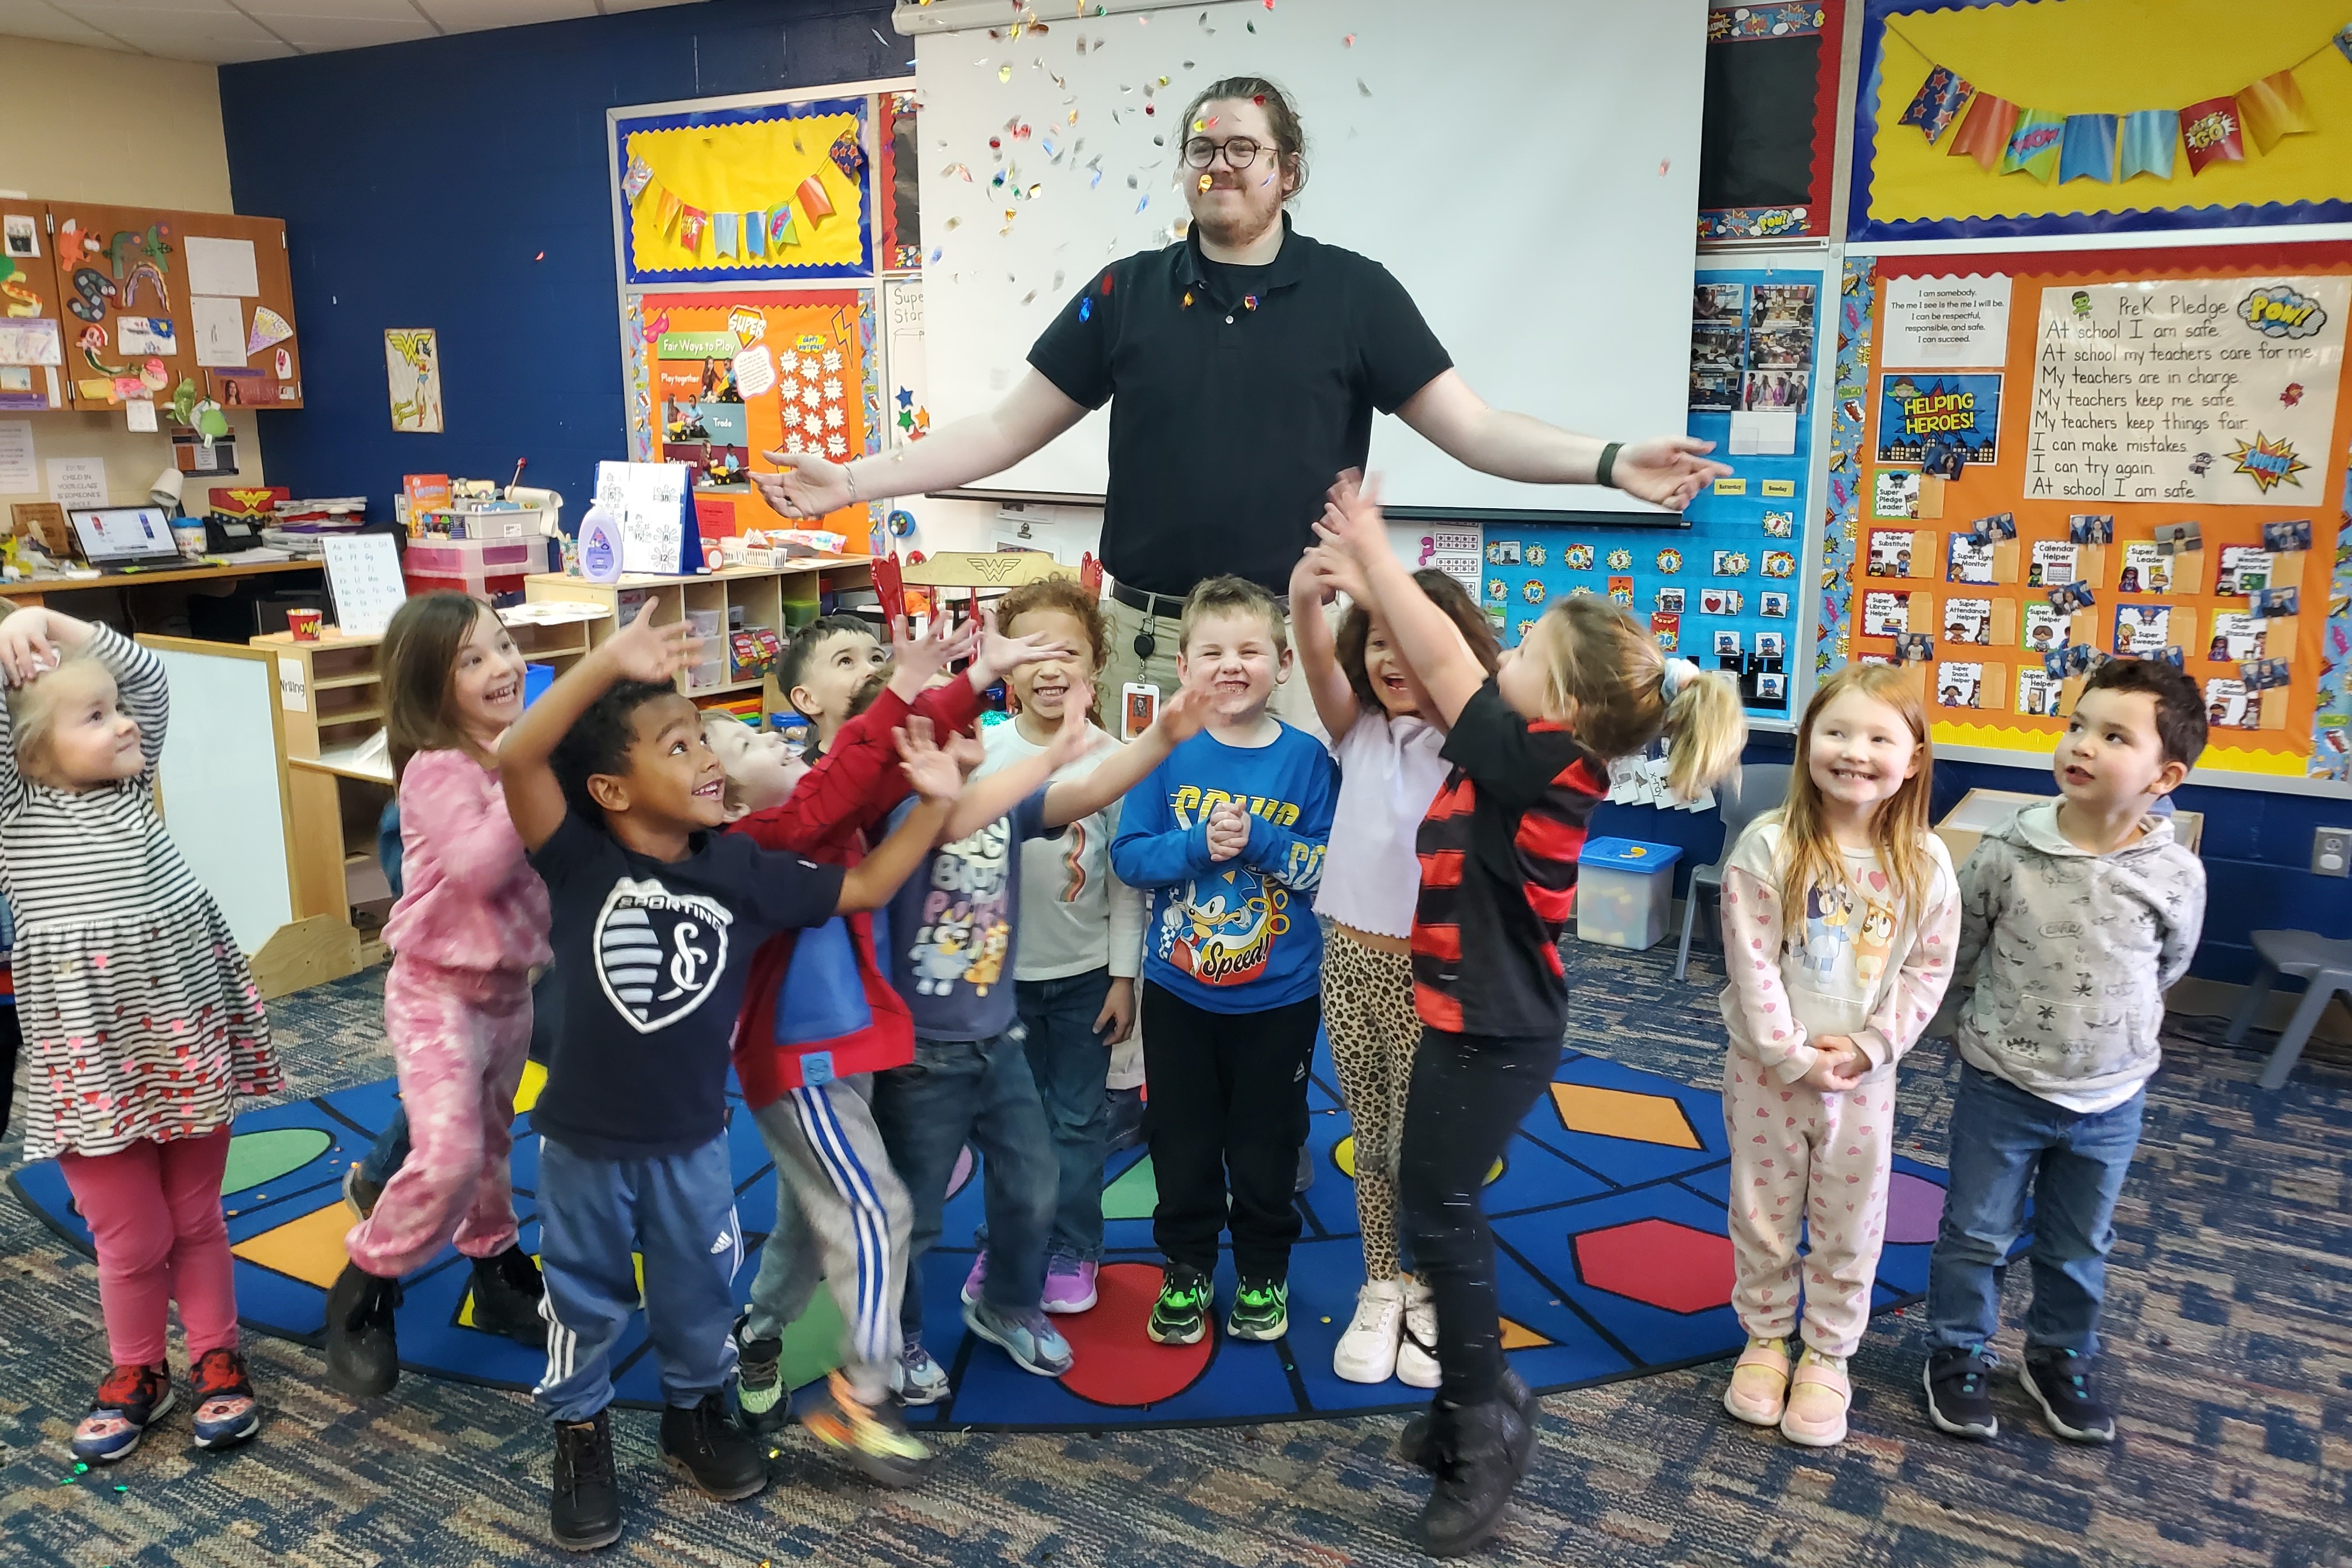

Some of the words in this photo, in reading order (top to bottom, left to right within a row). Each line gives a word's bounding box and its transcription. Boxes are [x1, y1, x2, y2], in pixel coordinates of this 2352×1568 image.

[2008, 128, 2060, 157] WOW
[2195, 123, 2224, 148] GO
[1760, 213, 1787, 232] POW!
[894, 288, 923, 311] Supe
[1937, 289, 1977, 298] somebody.
[2171, 295, 2229, 319] Pledge
[2250, 296, 2314, 327] POW!
[1943, 312, 1981, 321] respectful,
[729, 314, 766, 338] SUPER
[1905, 324, 1950, 332] responsible,
[2045, 321, 2070, 340] At
[2078, 320, 2120, 339] school
[2128, 319, 2143, 339] I
[2154, 326, 2176, 338] am
[2185, 319, 2221, 339] safe.
[664, 338, 678, 351] Fair
[679, 338, 704, 356] Ways
[706, 342, 714, 351] to
[716, 338, 736, 356] Play
[1938, 335, 1971, 343] succeed.
[2042, 343, 2066, 362] At
[2074, 343, 2116, 362] school
[2124, 350, 2145, 367] my
[2149, 345, 2212, 362] teachers
[2220, 348, 2252, 360] care
[2258, 341, 2281, 359] for
[661, 373, 674, 386] Play
[676, 373, 699, 387] together
[2043, 366, 2065, 388] My
[2072, 367, 2132, 384] teachers
[2138, 371, 2161, 384] are
[2168, 369, 2182, 383] in
[2188, 366, 2242, 391] charge.
[1904, 391, 1974, 416] HELPING
[2039, 388, 2060, 407] My
[2066, 389, 2127, 407] teachers
[2136, 387, 2164, 411] keep
[2172, 394, 2194, 406] me
[2202, 386, 2238, 407] safe.
[713, 417, 732, 428] Trade
[1905, 411, 1975, 435] HEROES!
[2035, 411, 2056, 430] My
[2061, 413, 2117, 429] teachers
[2126, 411, 2155, 433] keep
[2162, 412, 2210, 434] things
[2218, 410, 2249, 430] fair.
[2032, 432, 2045, 452] I
[2052, 439, 2076, 452] can
[2081, 435, 2119, 452] make
[2127, 435, 2189, 453] mistakes.
[681, 459, 698, 468] turns
[2033, 454, 2046, 473] I
[2054, 461, 2078, 473] can
[2084, 456, 2109, 477] try
[2115, 463, 2155, 482] again.
[2032, 477, 2054, 495] At
[2063, 478, 2105, 497] school
[2113, 478, 2127, 498] I
[2136, 485, 2157, 498] am
[2164, 480, 2197, 499] safe.
[1879, 496, 1903, 504] Pledge
[1772, 520, 1781, 530] 1
[2039, 544, 2076, 552] Calendar
[2043, 552, 2070, 562] Helper
[2131, 548, 2154, 556] Super
[660, 554, 668, 562] 12
[1533, 550, 1539, 561] 3
[1573, 552, 1580, 563] 4
[1615, 554, 1623, 565] 5
[1665, 556, 1673, 568] 6
[1732, 559, 1740, 569] 7
[1777, 558, 1785, 572] 8
[1962, 560, 1988, 568] Monitor
[1978, 554, 1994, 562] Light
[2136, 556, 2165, 564] Leader
[1659, 635, 1672, 646] 20
[2132, 638, 2165, 646] Sweeper
[2138, 631, 2160, 639] Super
[2031, 680, 2055, 688] Helper
[1649, 772, 1662, 798] x-ray
[1202, 932, 1270, 984] Speed!
